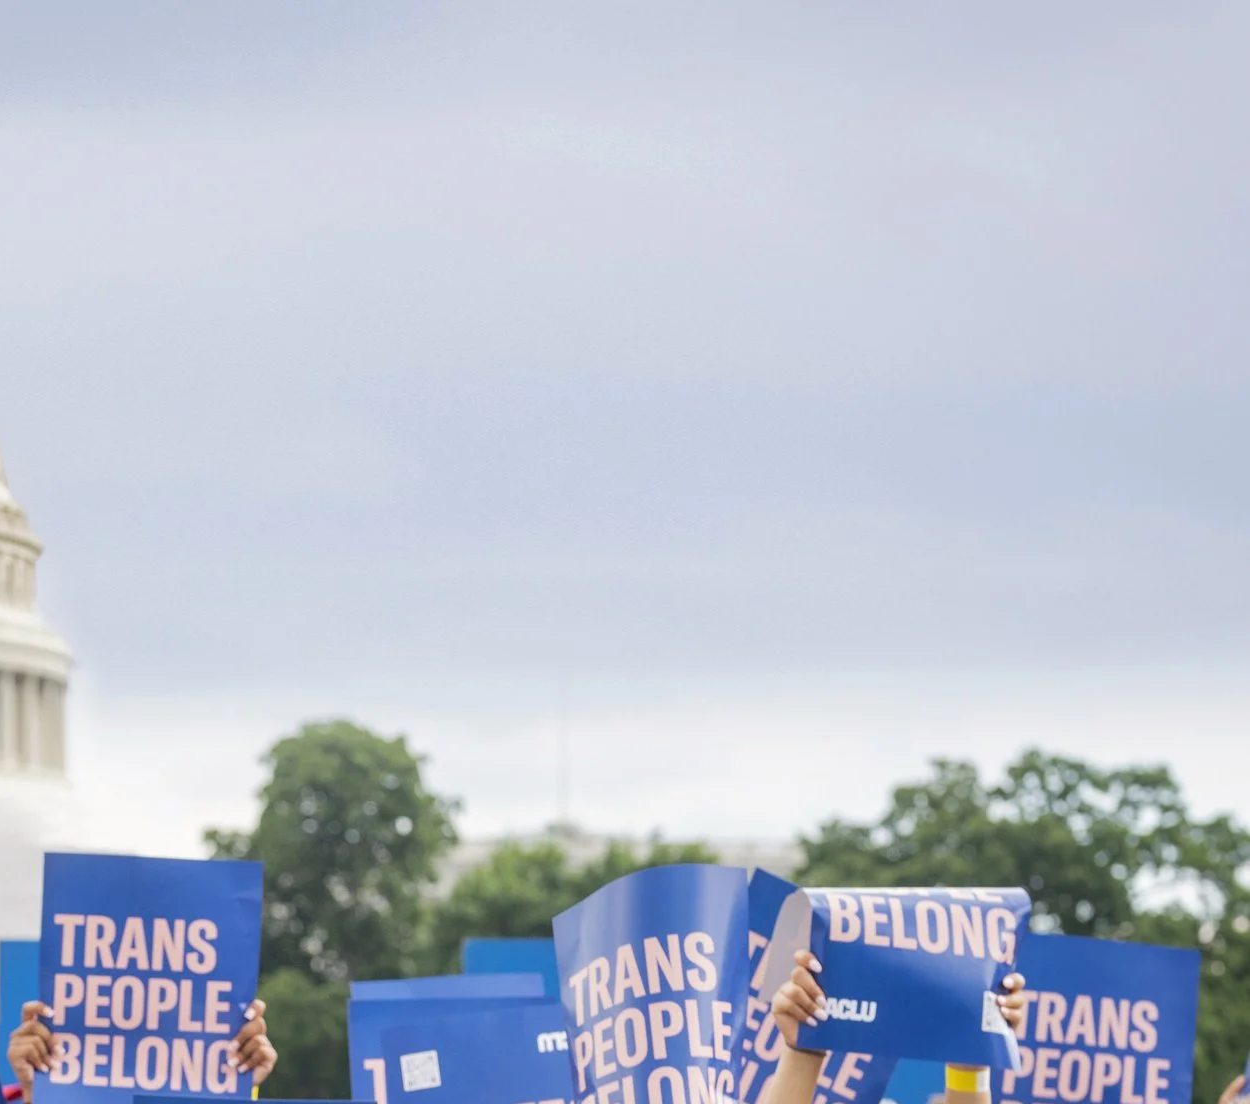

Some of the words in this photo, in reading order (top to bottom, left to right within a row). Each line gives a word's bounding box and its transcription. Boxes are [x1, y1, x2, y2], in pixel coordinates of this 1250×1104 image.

[53, 913, 219, 975] TRANS
[825, 891, 1018, 964] BELONG
[53, 973, 232, 1034] PEOPLE
[568, 931, 718, 1028] TRANS
[824, 996, 877, 1022] ACLU
[574, 999, 732, 1093] PEOPLE
[1014, 990, 1159, 1053] TRANS
[49, 1032, 238, 1095] BELONG
